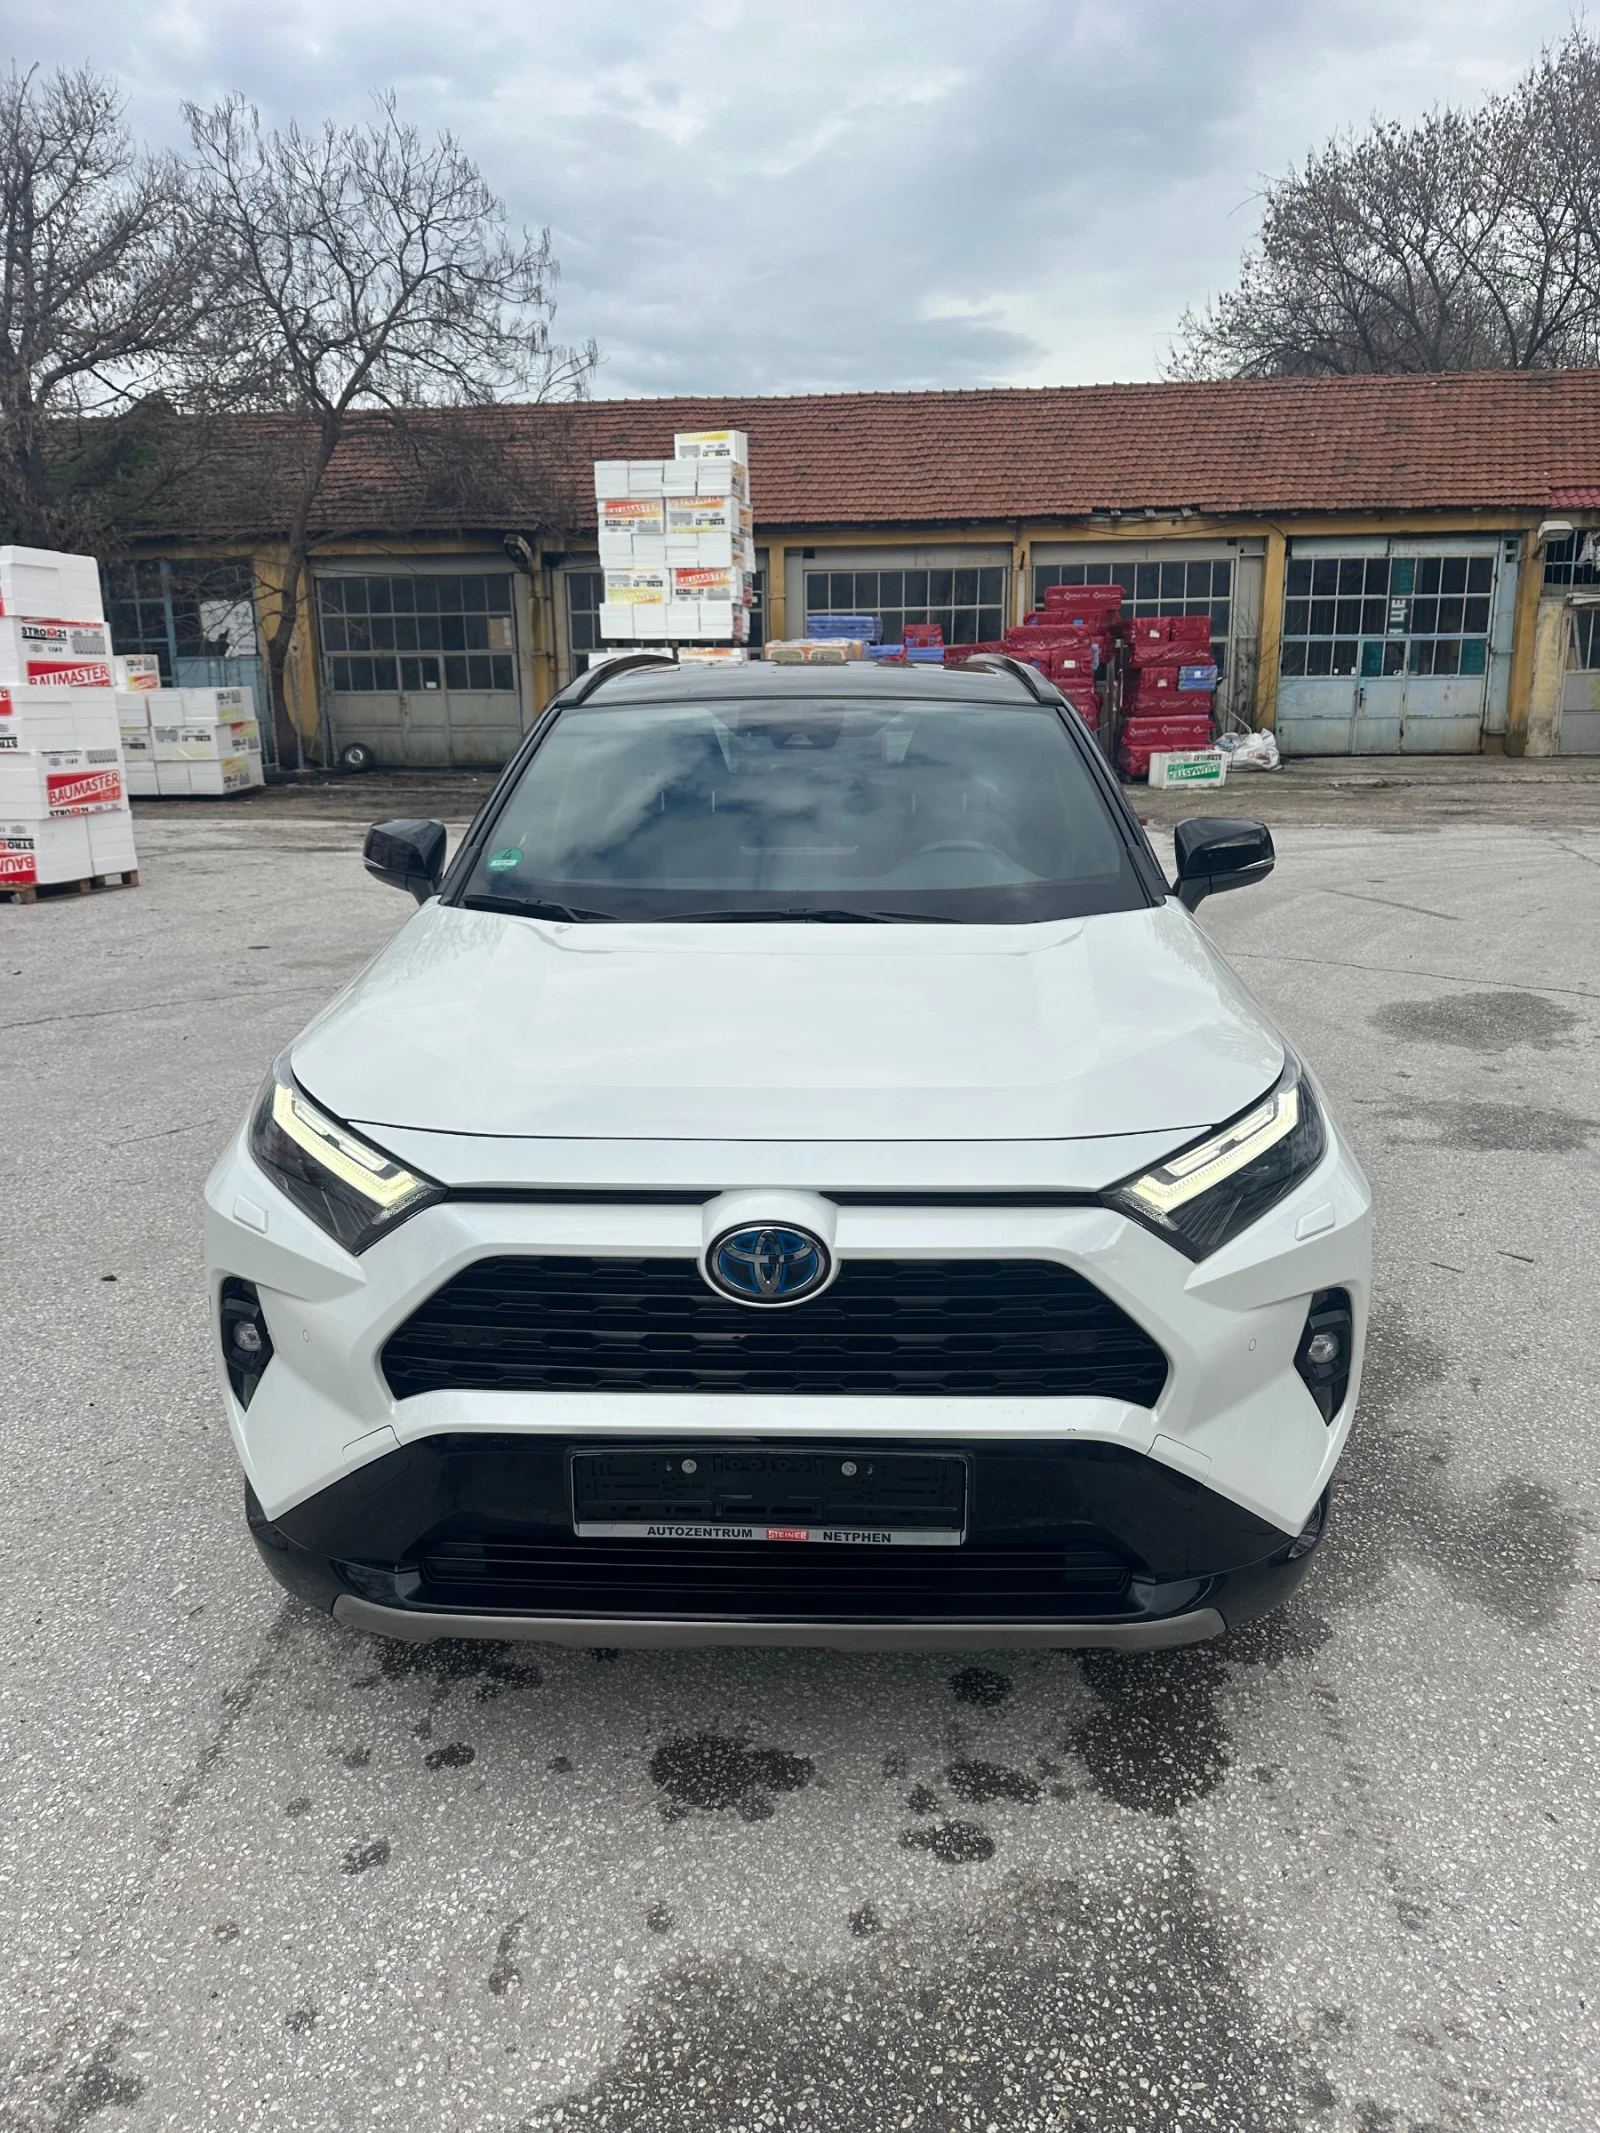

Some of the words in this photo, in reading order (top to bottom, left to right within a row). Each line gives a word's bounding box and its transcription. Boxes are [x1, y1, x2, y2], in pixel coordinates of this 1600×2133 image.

[49, 772, 120, 805] BAUMASTER
[502, 849, 512, 860] 4
[647, 1527, 752, 1538] AUTOZENTRUM
[768, 1529, 807, 1540] STEINER
[823, 1531, 891, 1543] NETPHEN
